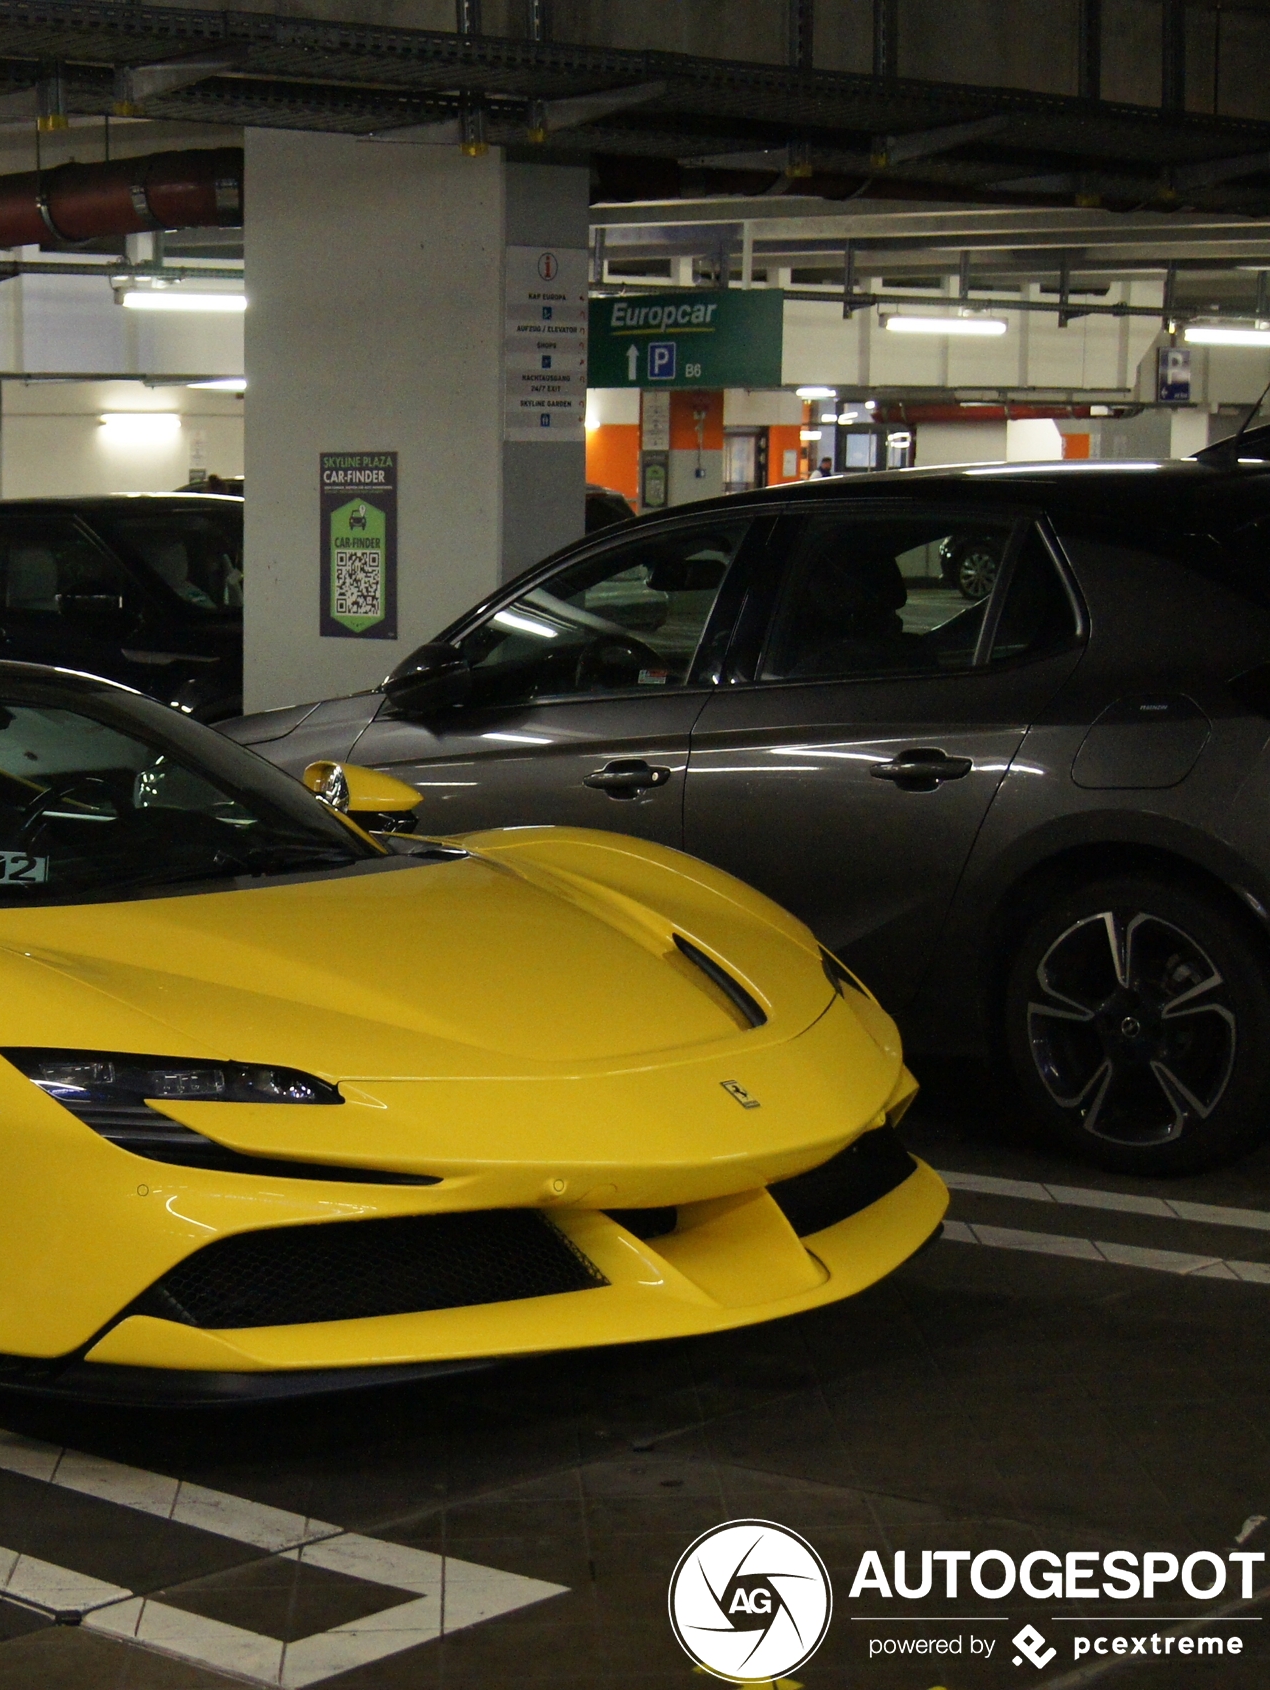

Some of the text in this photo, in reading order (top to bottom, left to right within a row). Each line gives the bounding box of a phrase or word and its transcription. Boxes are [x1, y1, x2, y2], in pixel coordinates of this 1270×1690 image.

[611, 302, 717, 332] Europcar
[537, 341, 557, 349] SHOPS
[654, 348, 702, 378] P B6
[1167, 351, 1183, 385] P
[547, 400, 572, 408] GARDEN
[323, 456, 393, 468] SKYLINE PLAZA
[323, 470, 386, 483] CAR-FINDER
[334, 537, 381, 549] CAR-FINDER
